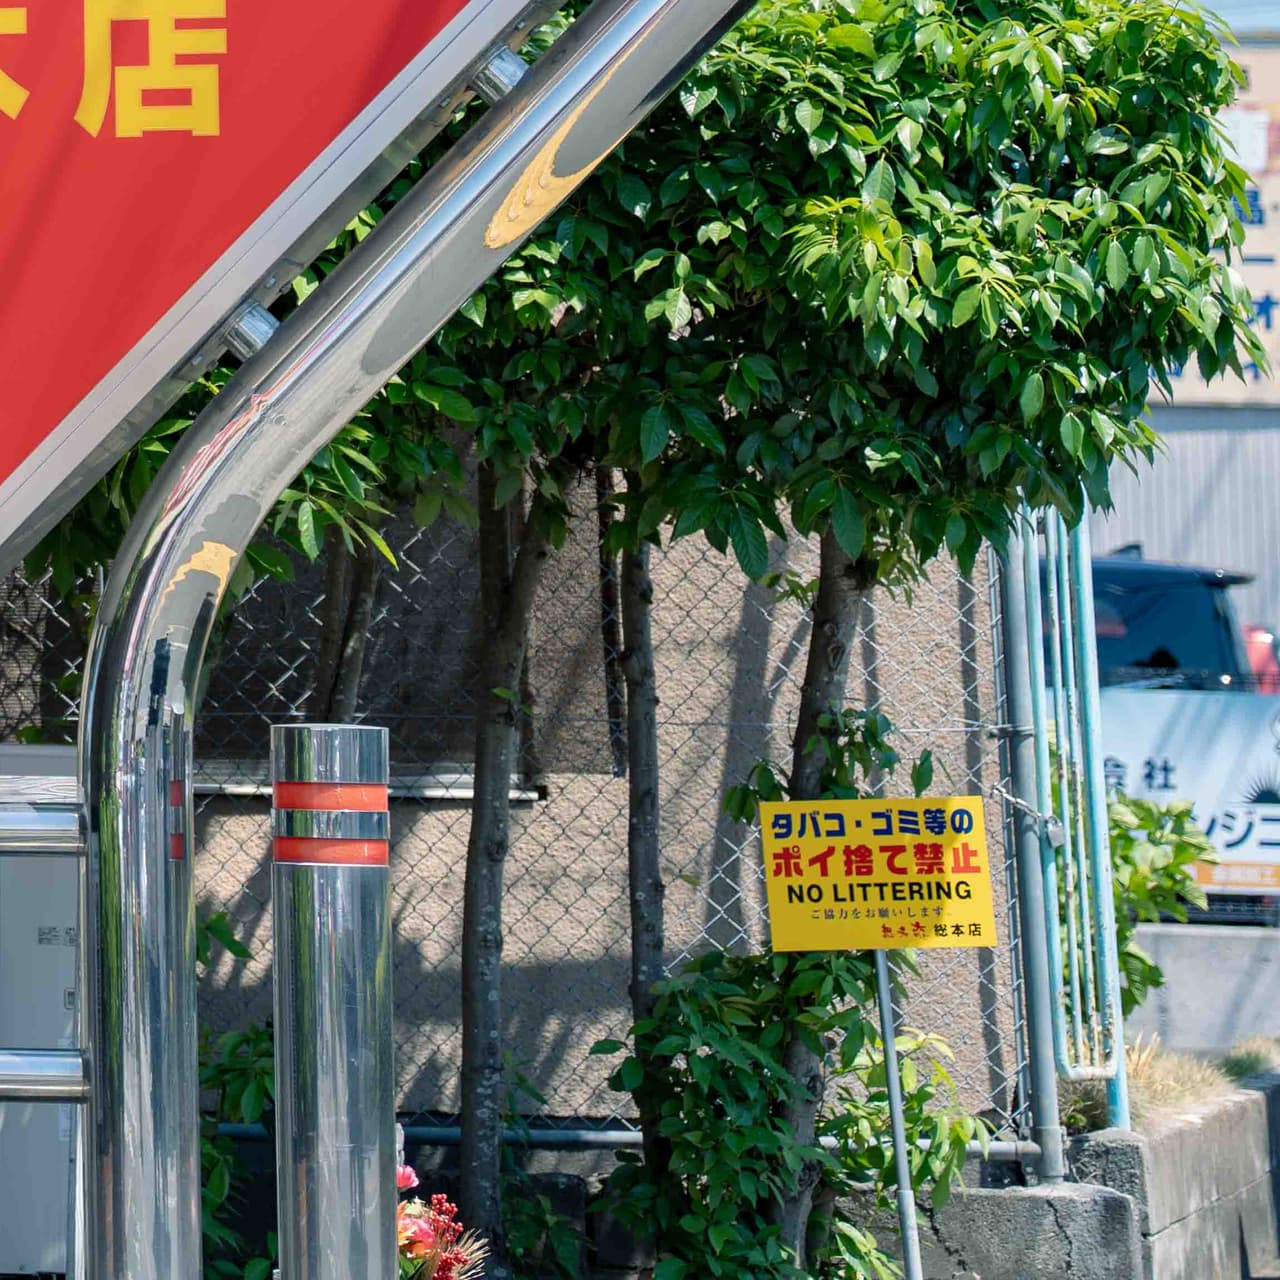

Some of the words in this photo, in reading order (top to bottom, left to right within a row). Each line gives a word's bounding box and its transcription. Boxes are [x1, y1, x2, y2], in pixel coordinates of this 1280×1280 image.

[771, 808, 974, 839] タバコ・ゴミ等の
[772, 842, 981, 877] ポイ捨て禁止
[787, 884, 823, 904] NO
[833, 881, 972, 902] LITTERING
[933, 923, 982, 937] 総本店
